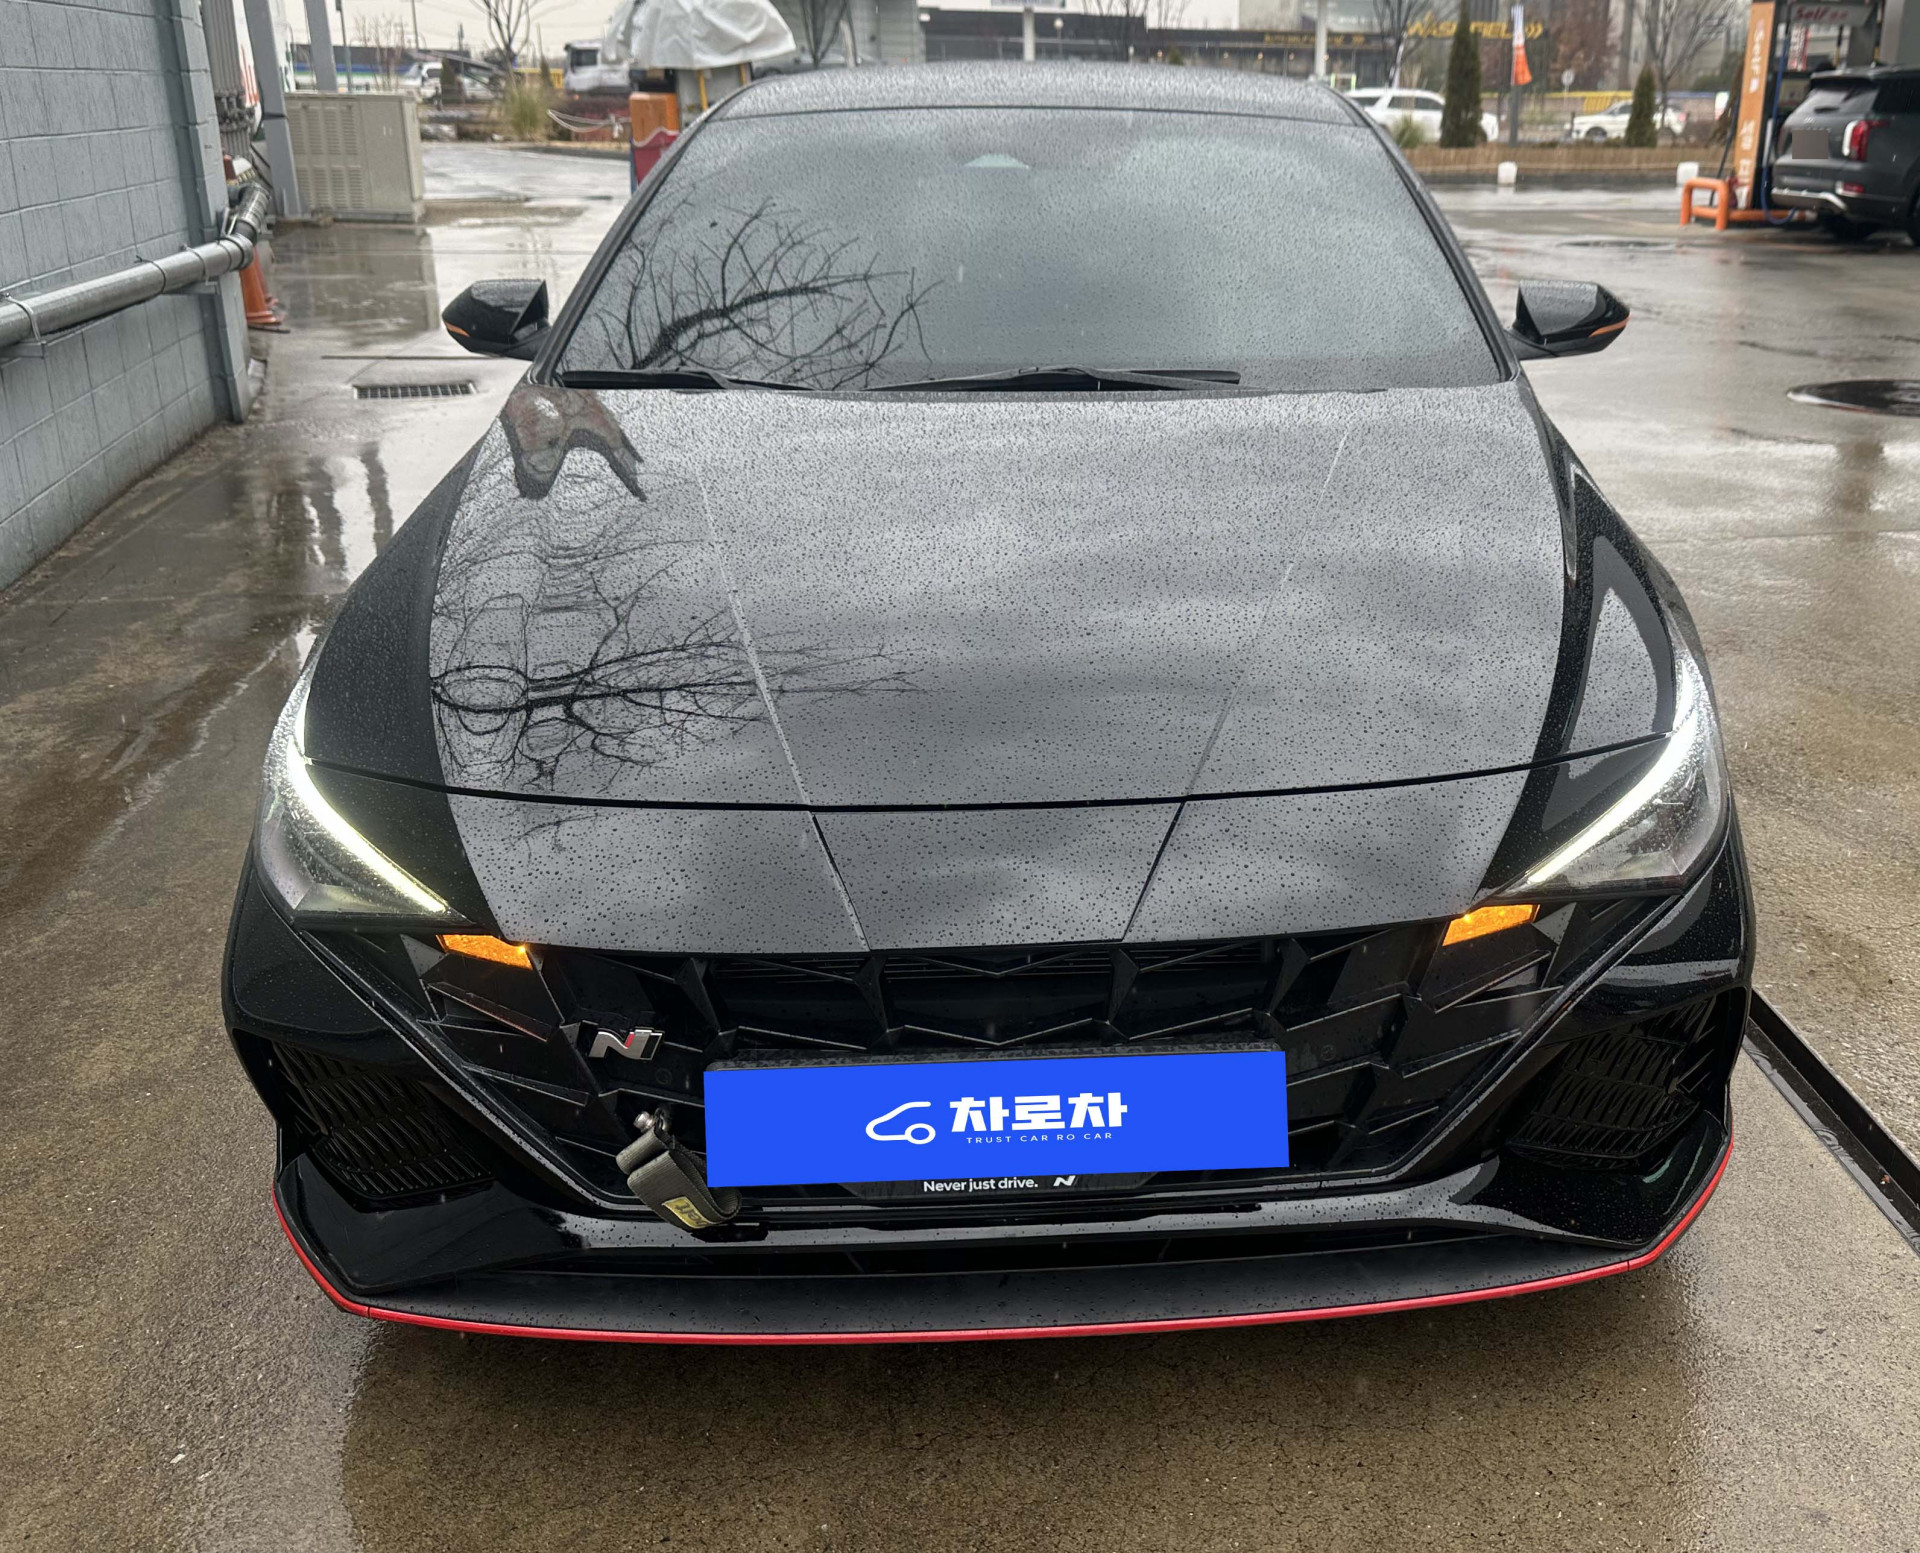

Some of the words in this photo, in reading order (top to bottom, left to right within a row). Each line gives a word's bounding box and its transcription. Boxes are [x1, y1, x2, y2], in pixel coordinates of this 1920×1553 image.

[923, 1181, 967, 1192] Never
[968, 1178, 996, 1193] just
[998, 1176, 1039, 1189] drive.
